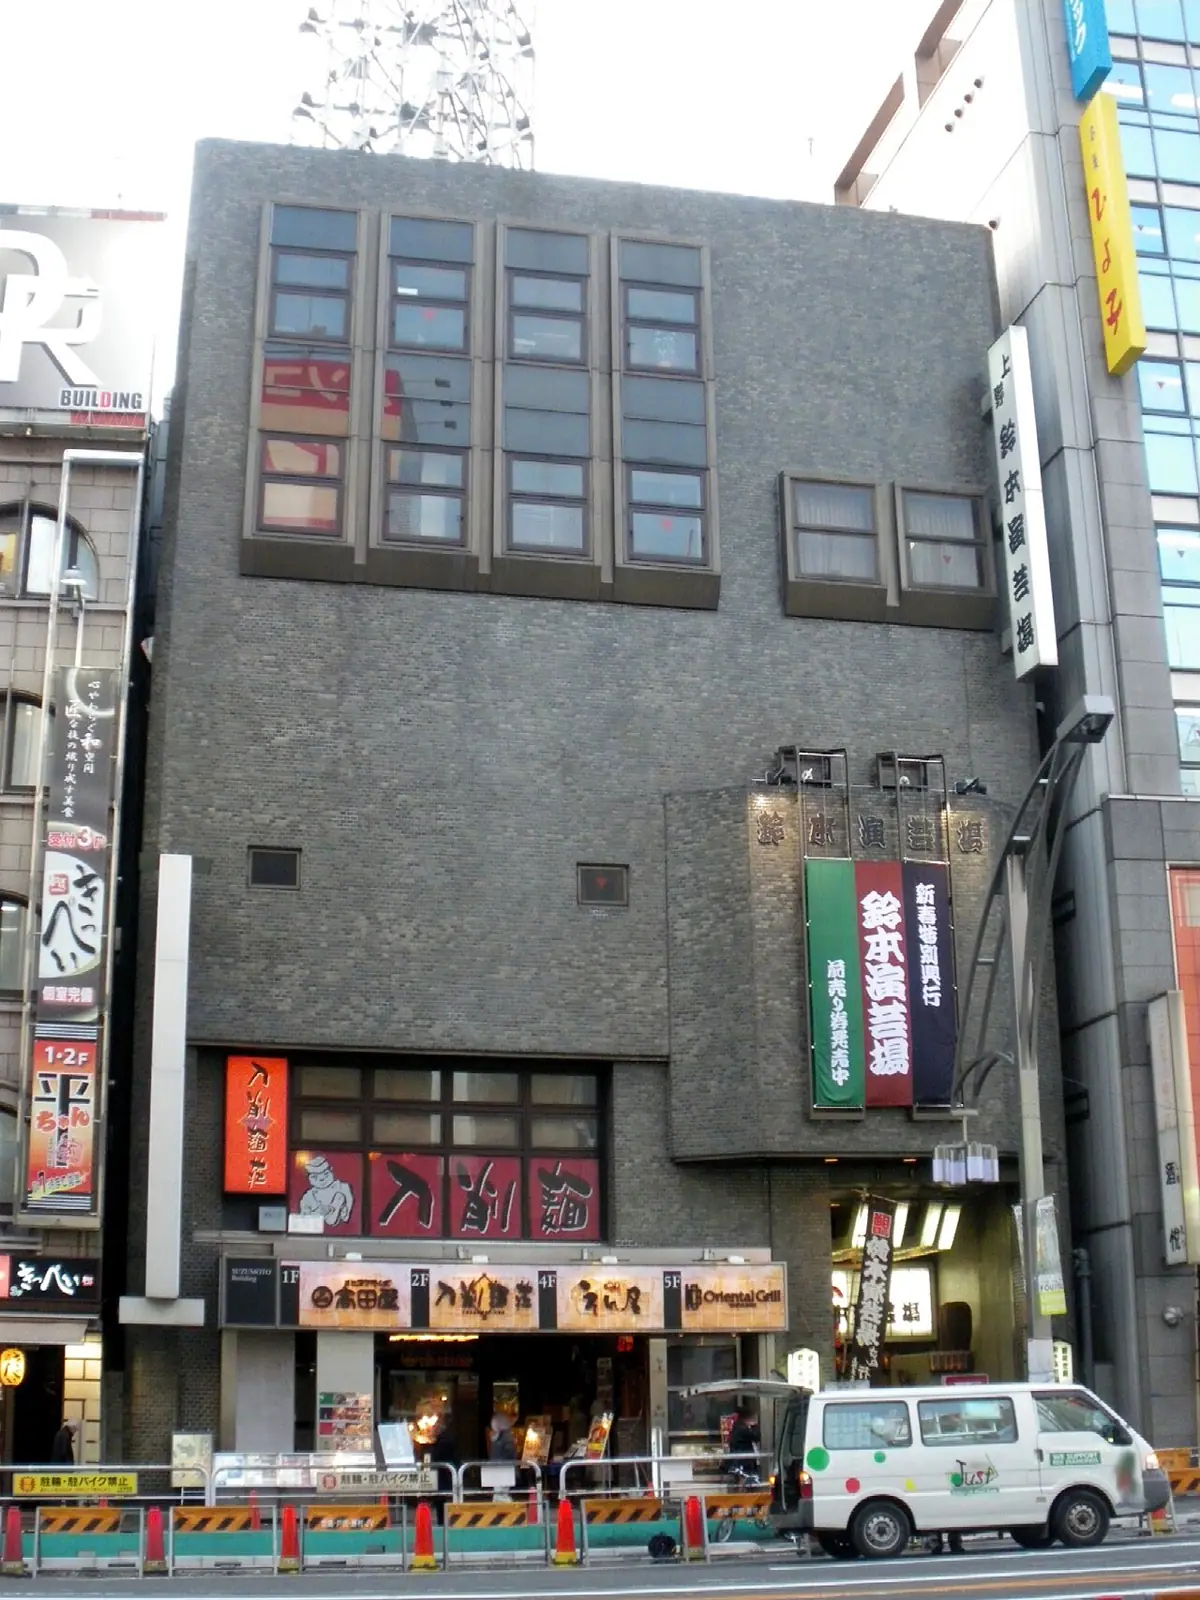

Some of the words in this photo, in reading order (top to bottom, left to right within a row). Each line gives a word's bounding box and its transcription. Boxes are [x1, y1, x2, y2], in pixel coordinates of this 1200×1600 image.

[60, 389, 143, 410] BUILDING
[860, 890, 909, 1076] 鈴本演芸場
[282, 1271, 300, 1284] 1F
[411, 1273, 430, 1287] 2F
[538, 1275, 556, 1289] 4F
[664, 1276, 681, 1289] 5F
[704, 1290, 754, 1304] Oriental
[755, 1290, 781, 1303] Grill
[40, 1476, 129, 1487] 駐輪・駐バイク禁止
